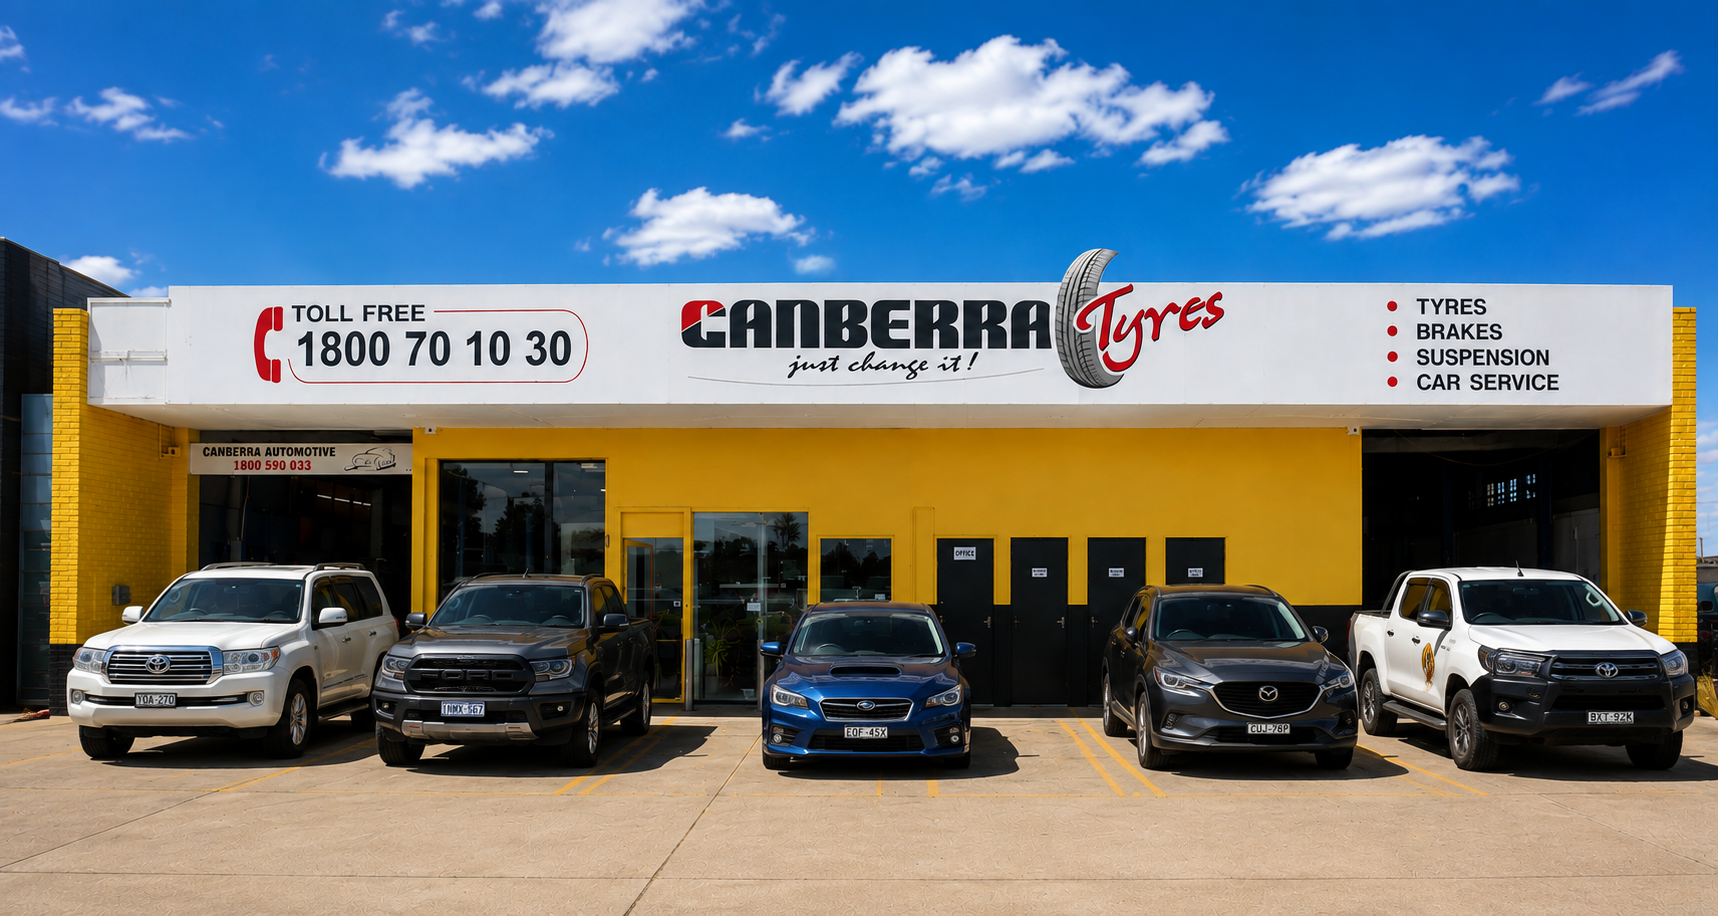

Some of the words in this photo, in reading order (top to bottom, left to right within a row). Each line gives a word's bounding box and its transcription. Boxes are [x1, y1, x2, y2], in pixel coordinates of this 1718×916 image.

[292, 304, 353, 322] TOLL
[363, 304, 426, 322] FREE
[1416, 298, 1487, 315] TYRES
[681, 299, 1052, 349] CANBERRA
[1076, 283, 1225, 373] Tyres
[1416, 323, 1503, 340] BRAKES
[297, 330, 390, 366] 1800
[405, 330, 451, 366] 70
[466, 330, 511, 366] 10
[525, 330, 572, 366] 30
[1416, 348, 1550, 366] SUSPENSION
[787, 354, 840, 379] just
[847, 350, 929, 381] change
[1416, 373, 1461, 391] CAR
[1469, 373, 1560, 391] SERVICE
[202, 446, 261, 457] CANBERRA
[264, 446, 336, 457] AUTOMOTIVE
[233, 459, 262, 471] 1800
[264, 459, 287, 471] 590
[289, 459, 312, 471] 033
